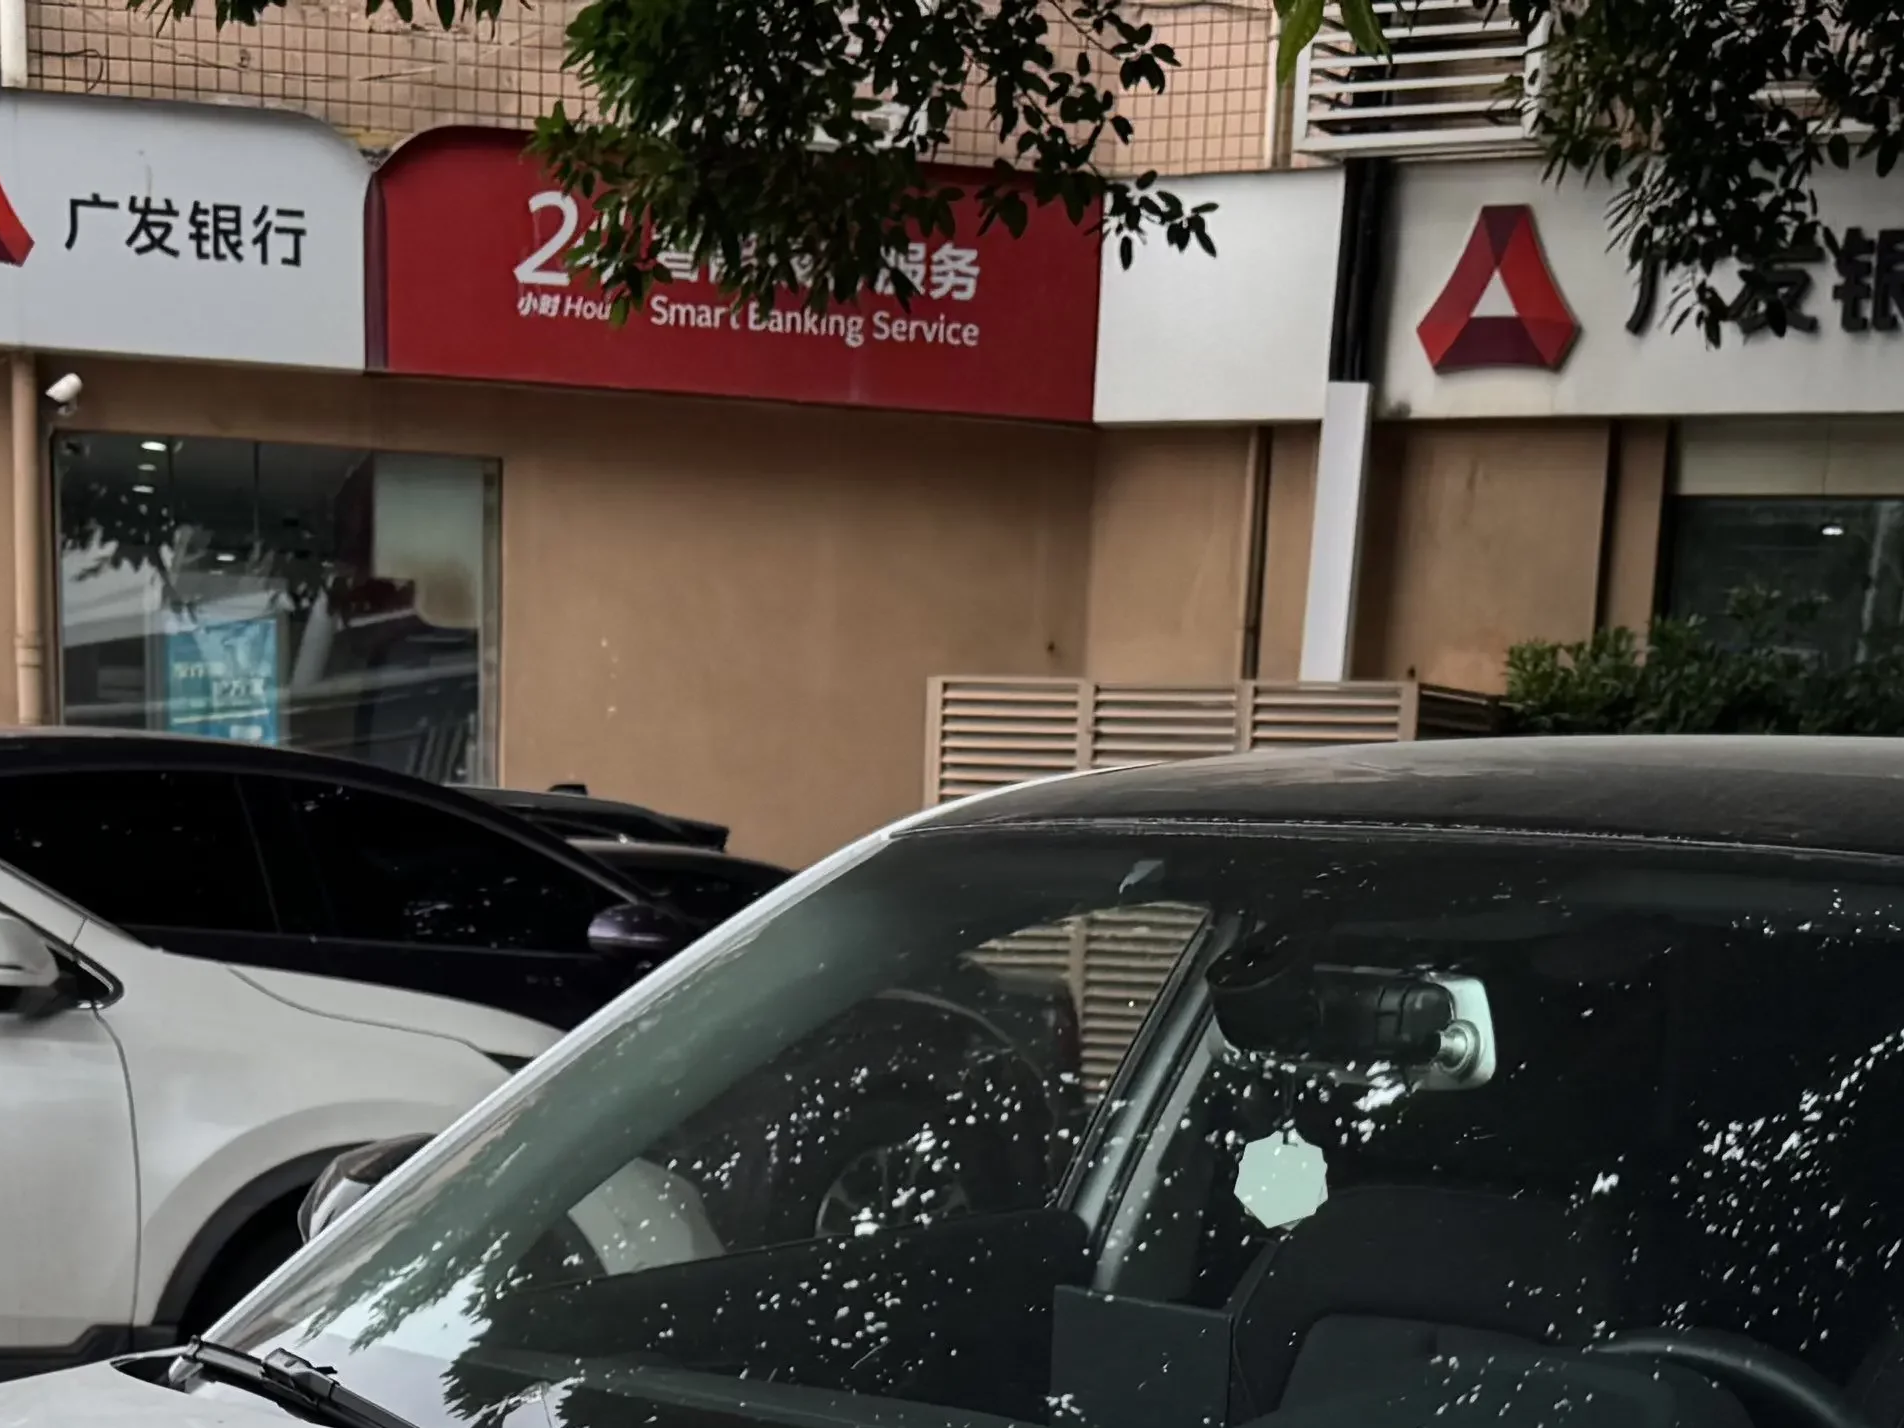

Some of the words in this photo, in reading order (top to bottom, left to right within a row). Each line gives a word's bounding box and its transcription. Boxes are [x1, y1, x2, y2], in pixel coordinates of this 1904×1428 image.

[64, 192, 307, 267] 广发银行
[563, 295, 614, 320] Hou
[872, 310, 980, 346] Service
